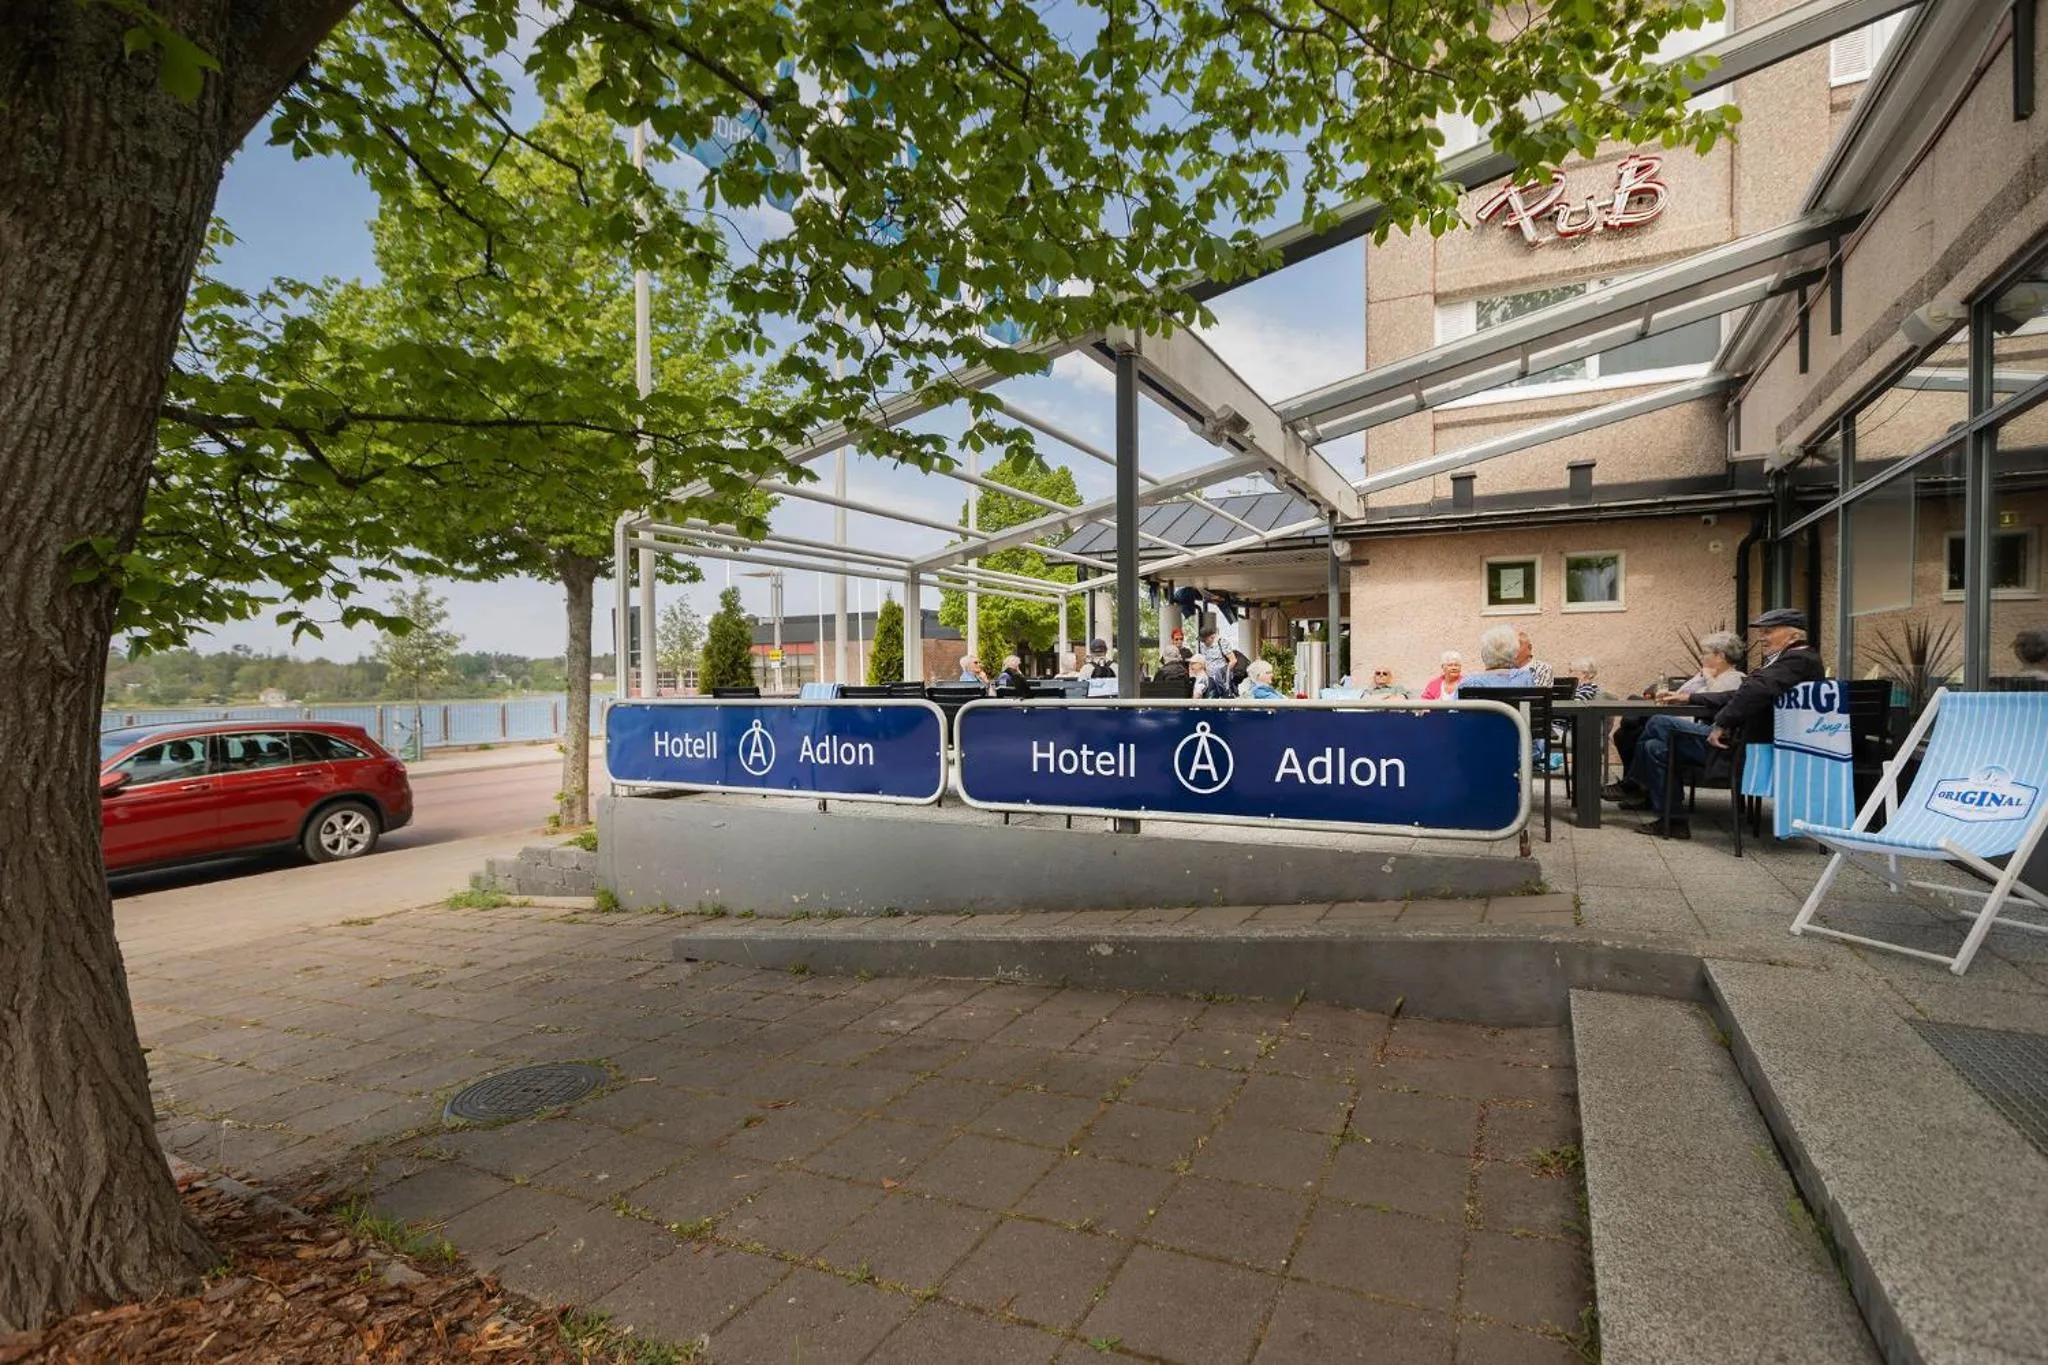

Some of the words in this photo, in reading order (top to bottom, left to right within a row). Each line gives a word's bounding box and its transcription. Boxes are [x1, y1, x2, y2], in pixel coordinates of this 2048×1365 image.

[654, 731, 718, 759] Hotell
[799, 735, 874, 766] Adlon
[1032, 740, 1136, 778] Hotell
[1274, 747, 1405, 787] Adlon
[1938, 790, 2023, 807] ORIGINAL
